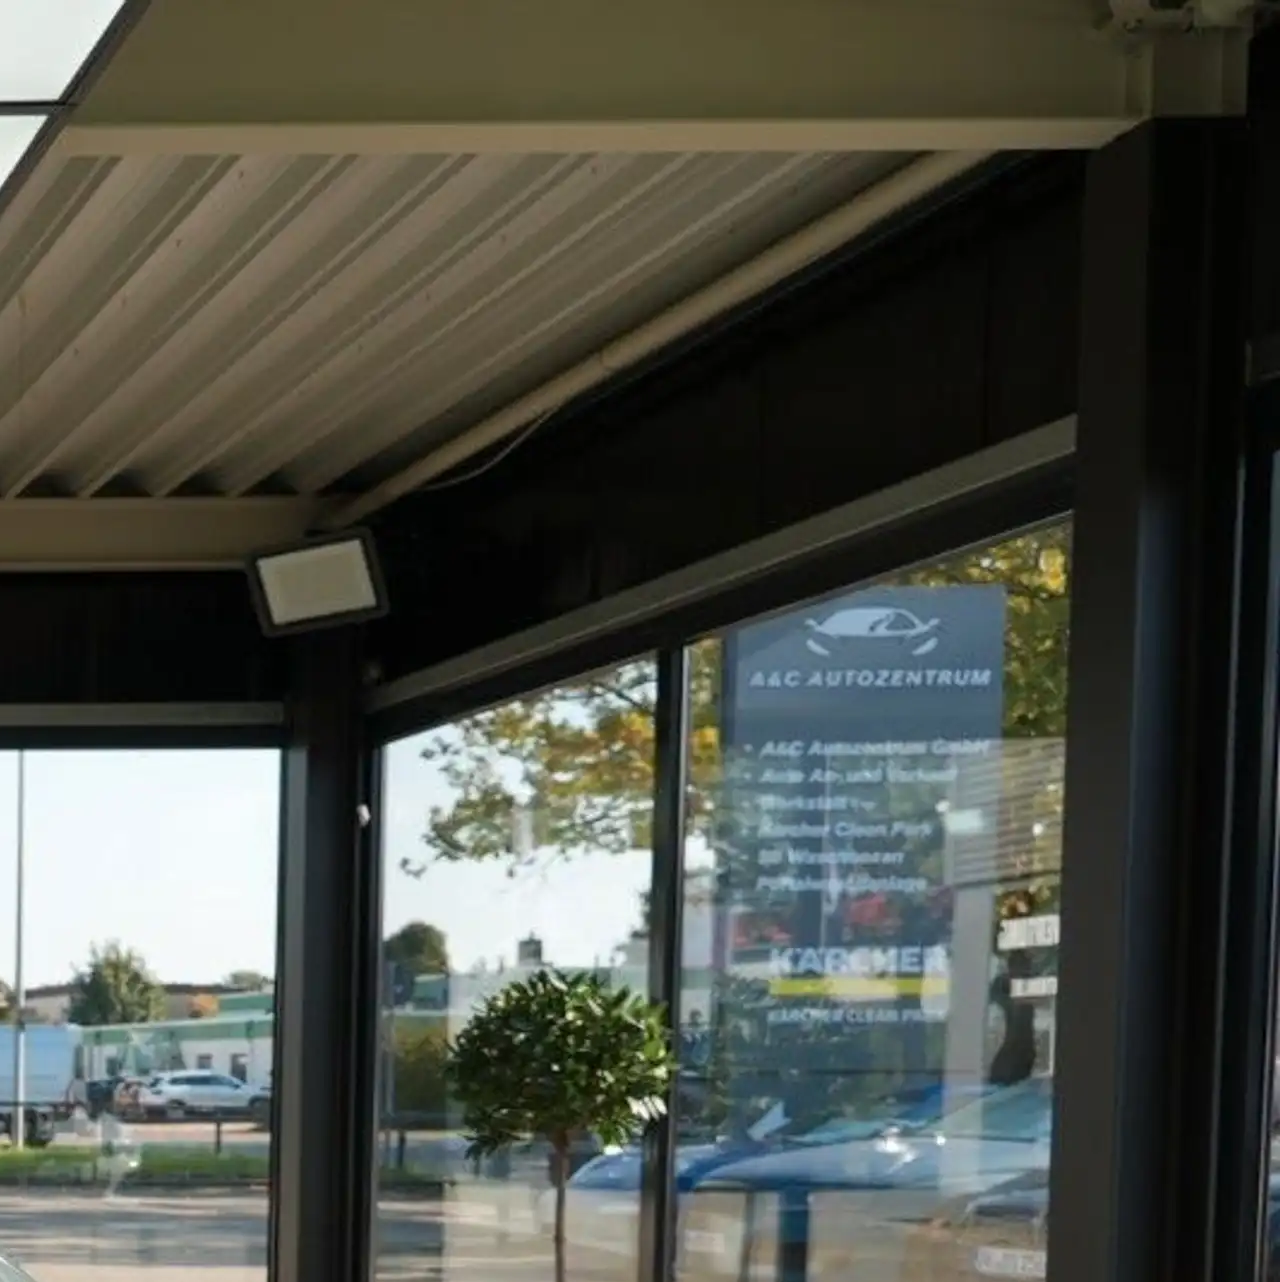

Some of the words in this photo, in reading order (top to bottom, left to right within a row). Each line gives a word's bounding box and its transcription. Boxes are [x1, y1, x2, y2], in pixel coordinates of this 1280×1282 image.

[748, 669, 802, 687] A&C
[807, 668, 993, 687] AUTOZENTRUM
[759, 740, 805, 758] A&C
